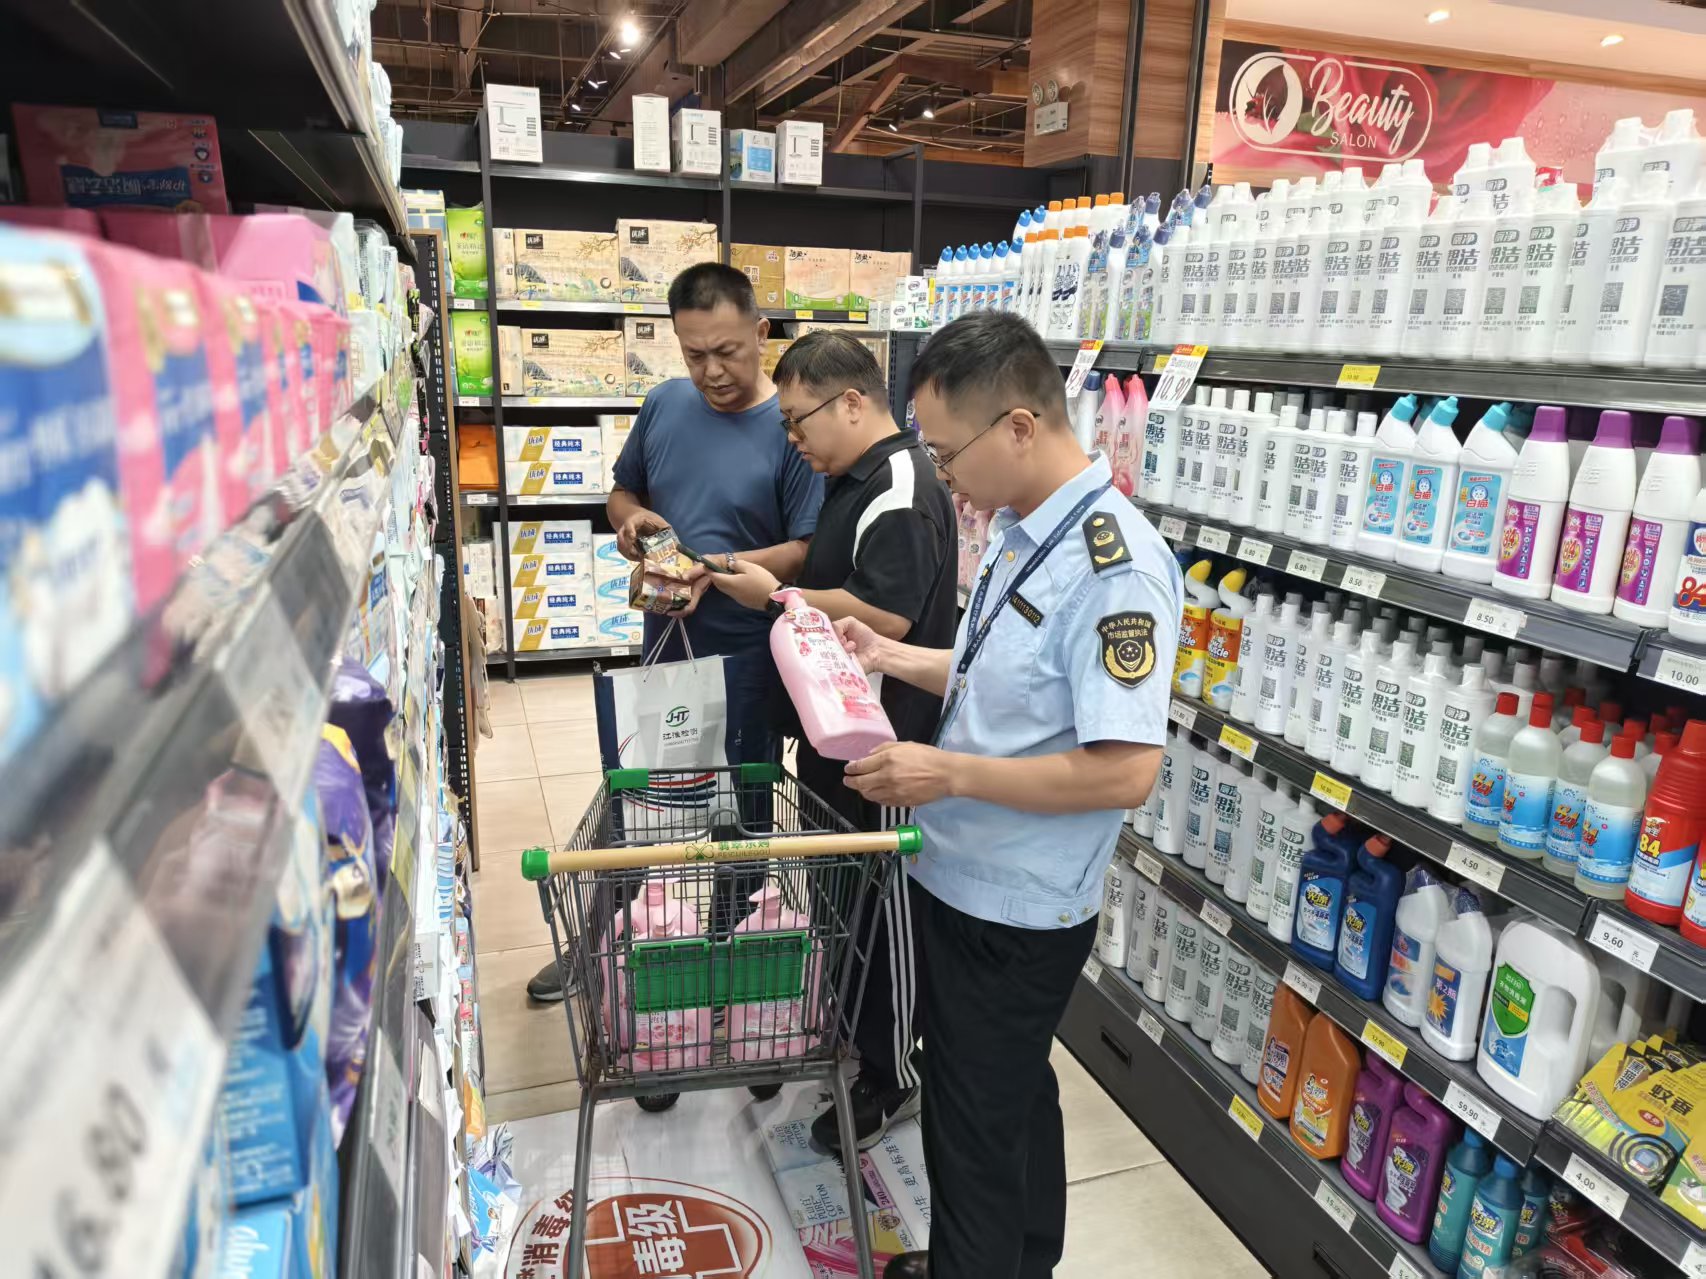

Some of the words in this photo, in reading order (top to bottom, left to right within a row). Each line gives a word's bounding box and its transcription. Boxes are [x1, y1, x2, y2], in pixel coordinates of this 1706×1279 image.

[1309, 57, 1414, 156] Beauty
[1330, 131, 1378, 149] SALON
[1447, 250, 1480, 266] 帮洁
[1490, 247, 1522, 264] 帮洁
[1526, 244, 1557, 262] 帮洁
[1156, 374, 1192, 401] 10.90
[1100, 616, 1153, 634] 中华人民共和国
[1476, 612, 1495, 625] 8.50
[1670, 669, 1700, 685] 10.00
[1372, 693, 1402, 713] 帮洁
[665, 709, 690, 723] JHT
[1402, 705, 1428, 726] 帮洁
[1440, 718, 1472, 741] 帮洁
[1553, 803, 1581, 830] 84
[1639, 833, 1661, 858] 84
[1461, 857, 1479, 871] 4.50
[1602, 931, 1624, 949] 9.60
[1614, 1057, 1646, 1092] 黑猫神
[1648, 1084, 1694, 1116] 蚊香
[1457, 1100, 1480, 1121] 59.90
[1575, 1172, 1596, 1191] 4.00
[812, 1194, 828, 1220] PURE
[816, 1183, 838, 1218] COTTON
[877, 1190, 890, 1205] 240
[624, 1199, 688, 1275] 毒级
